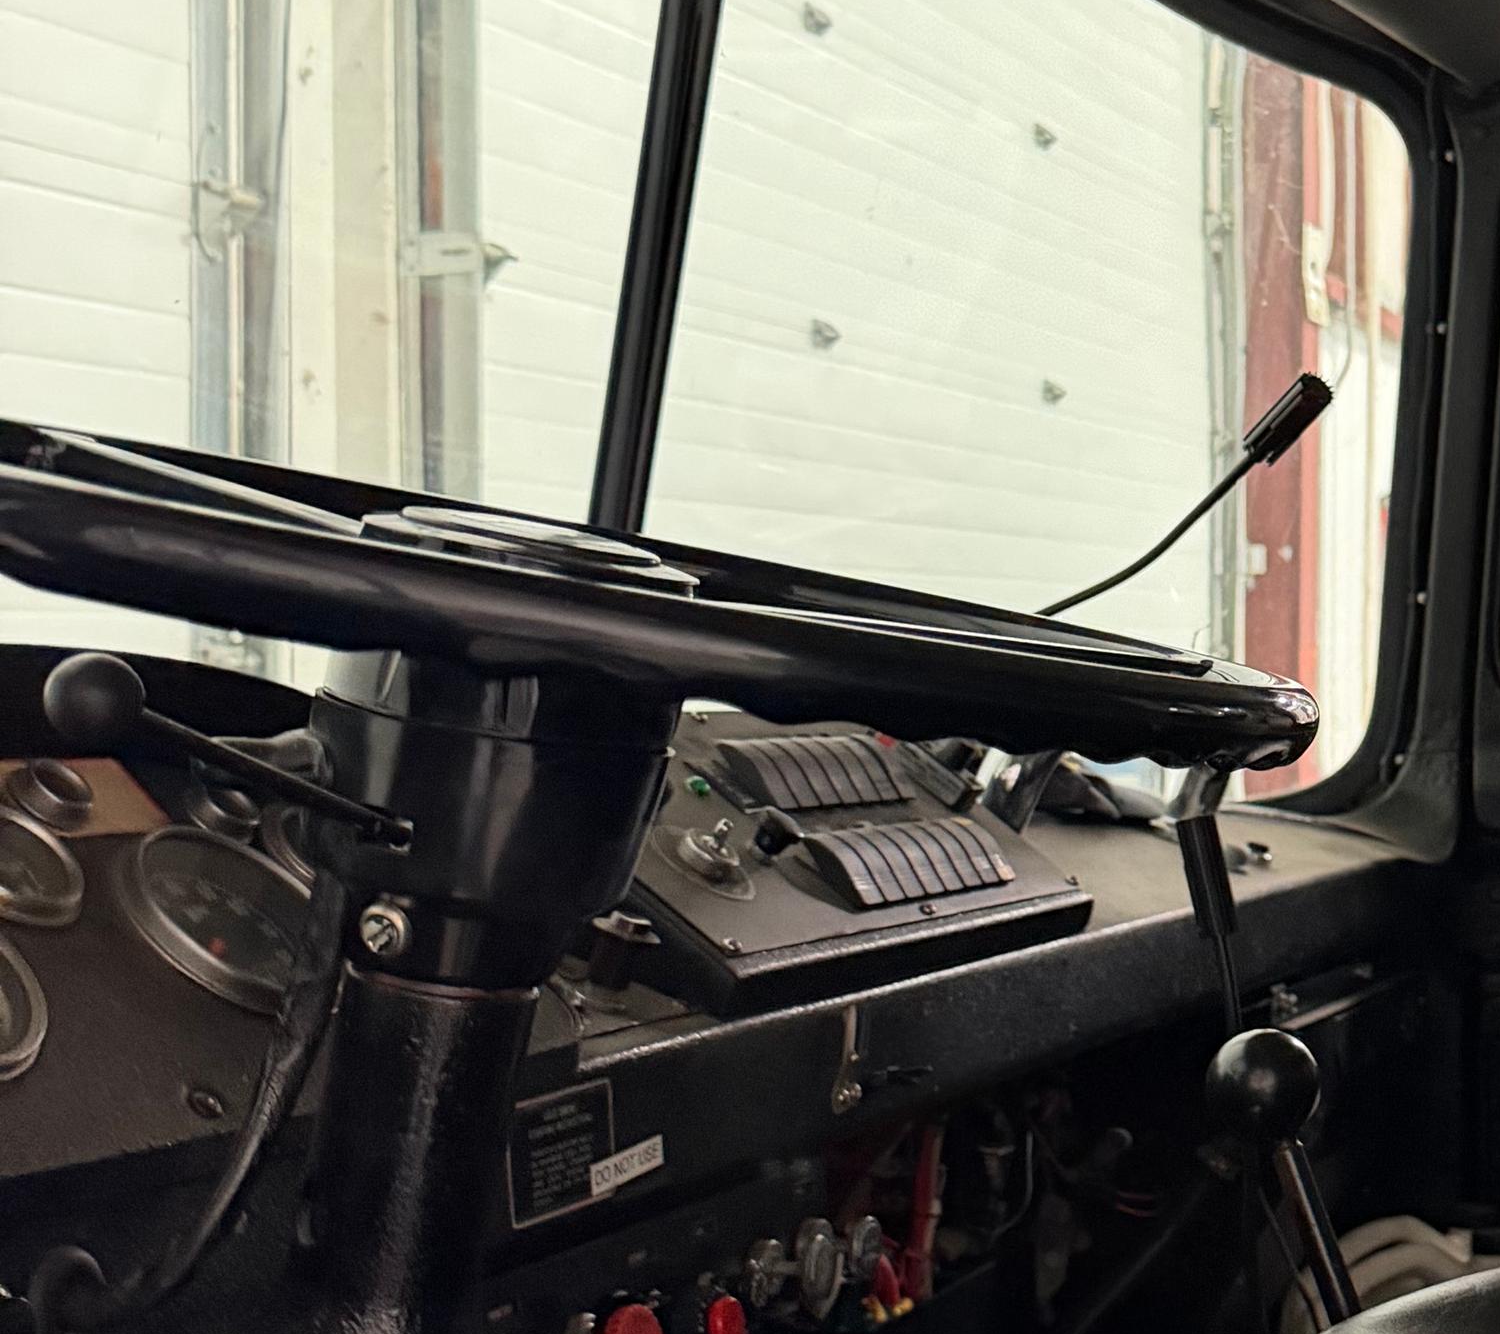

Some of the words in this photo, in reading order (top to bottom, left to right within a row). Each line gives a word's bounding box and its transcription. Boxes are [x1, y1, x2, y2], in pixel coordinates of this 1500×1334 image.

[594, 1165, 611, 1186] DO
[613, 1152, 637, 1178] NOT
[638, 1142, 659, 1166] USE
